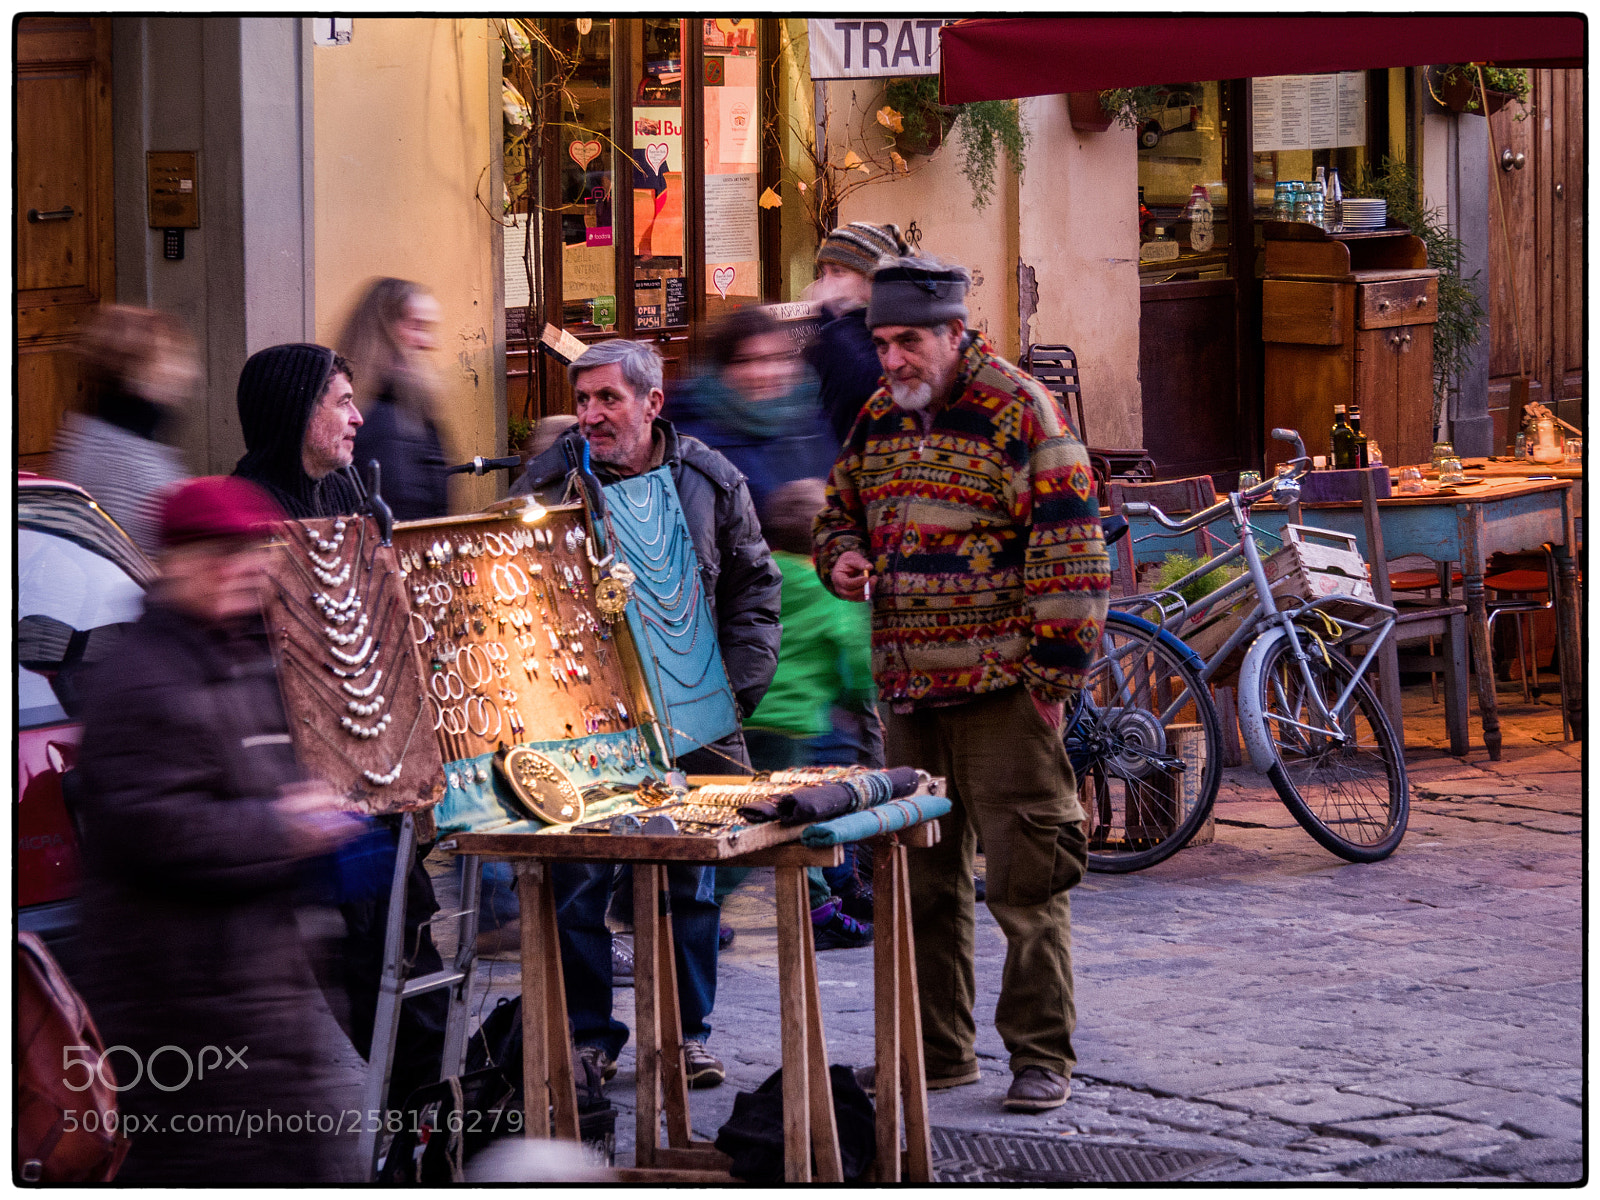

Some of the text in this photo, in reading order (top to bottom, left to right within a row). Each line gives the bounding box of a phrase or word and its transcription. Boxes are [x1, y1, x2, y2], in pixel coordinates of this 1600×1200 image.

[834, 20, 946, 69] TRAT
[634, 119, 662, 136] Rd
[638, 306, 656, 315] OPEN
[637, 316, 660, 328] PUSH
